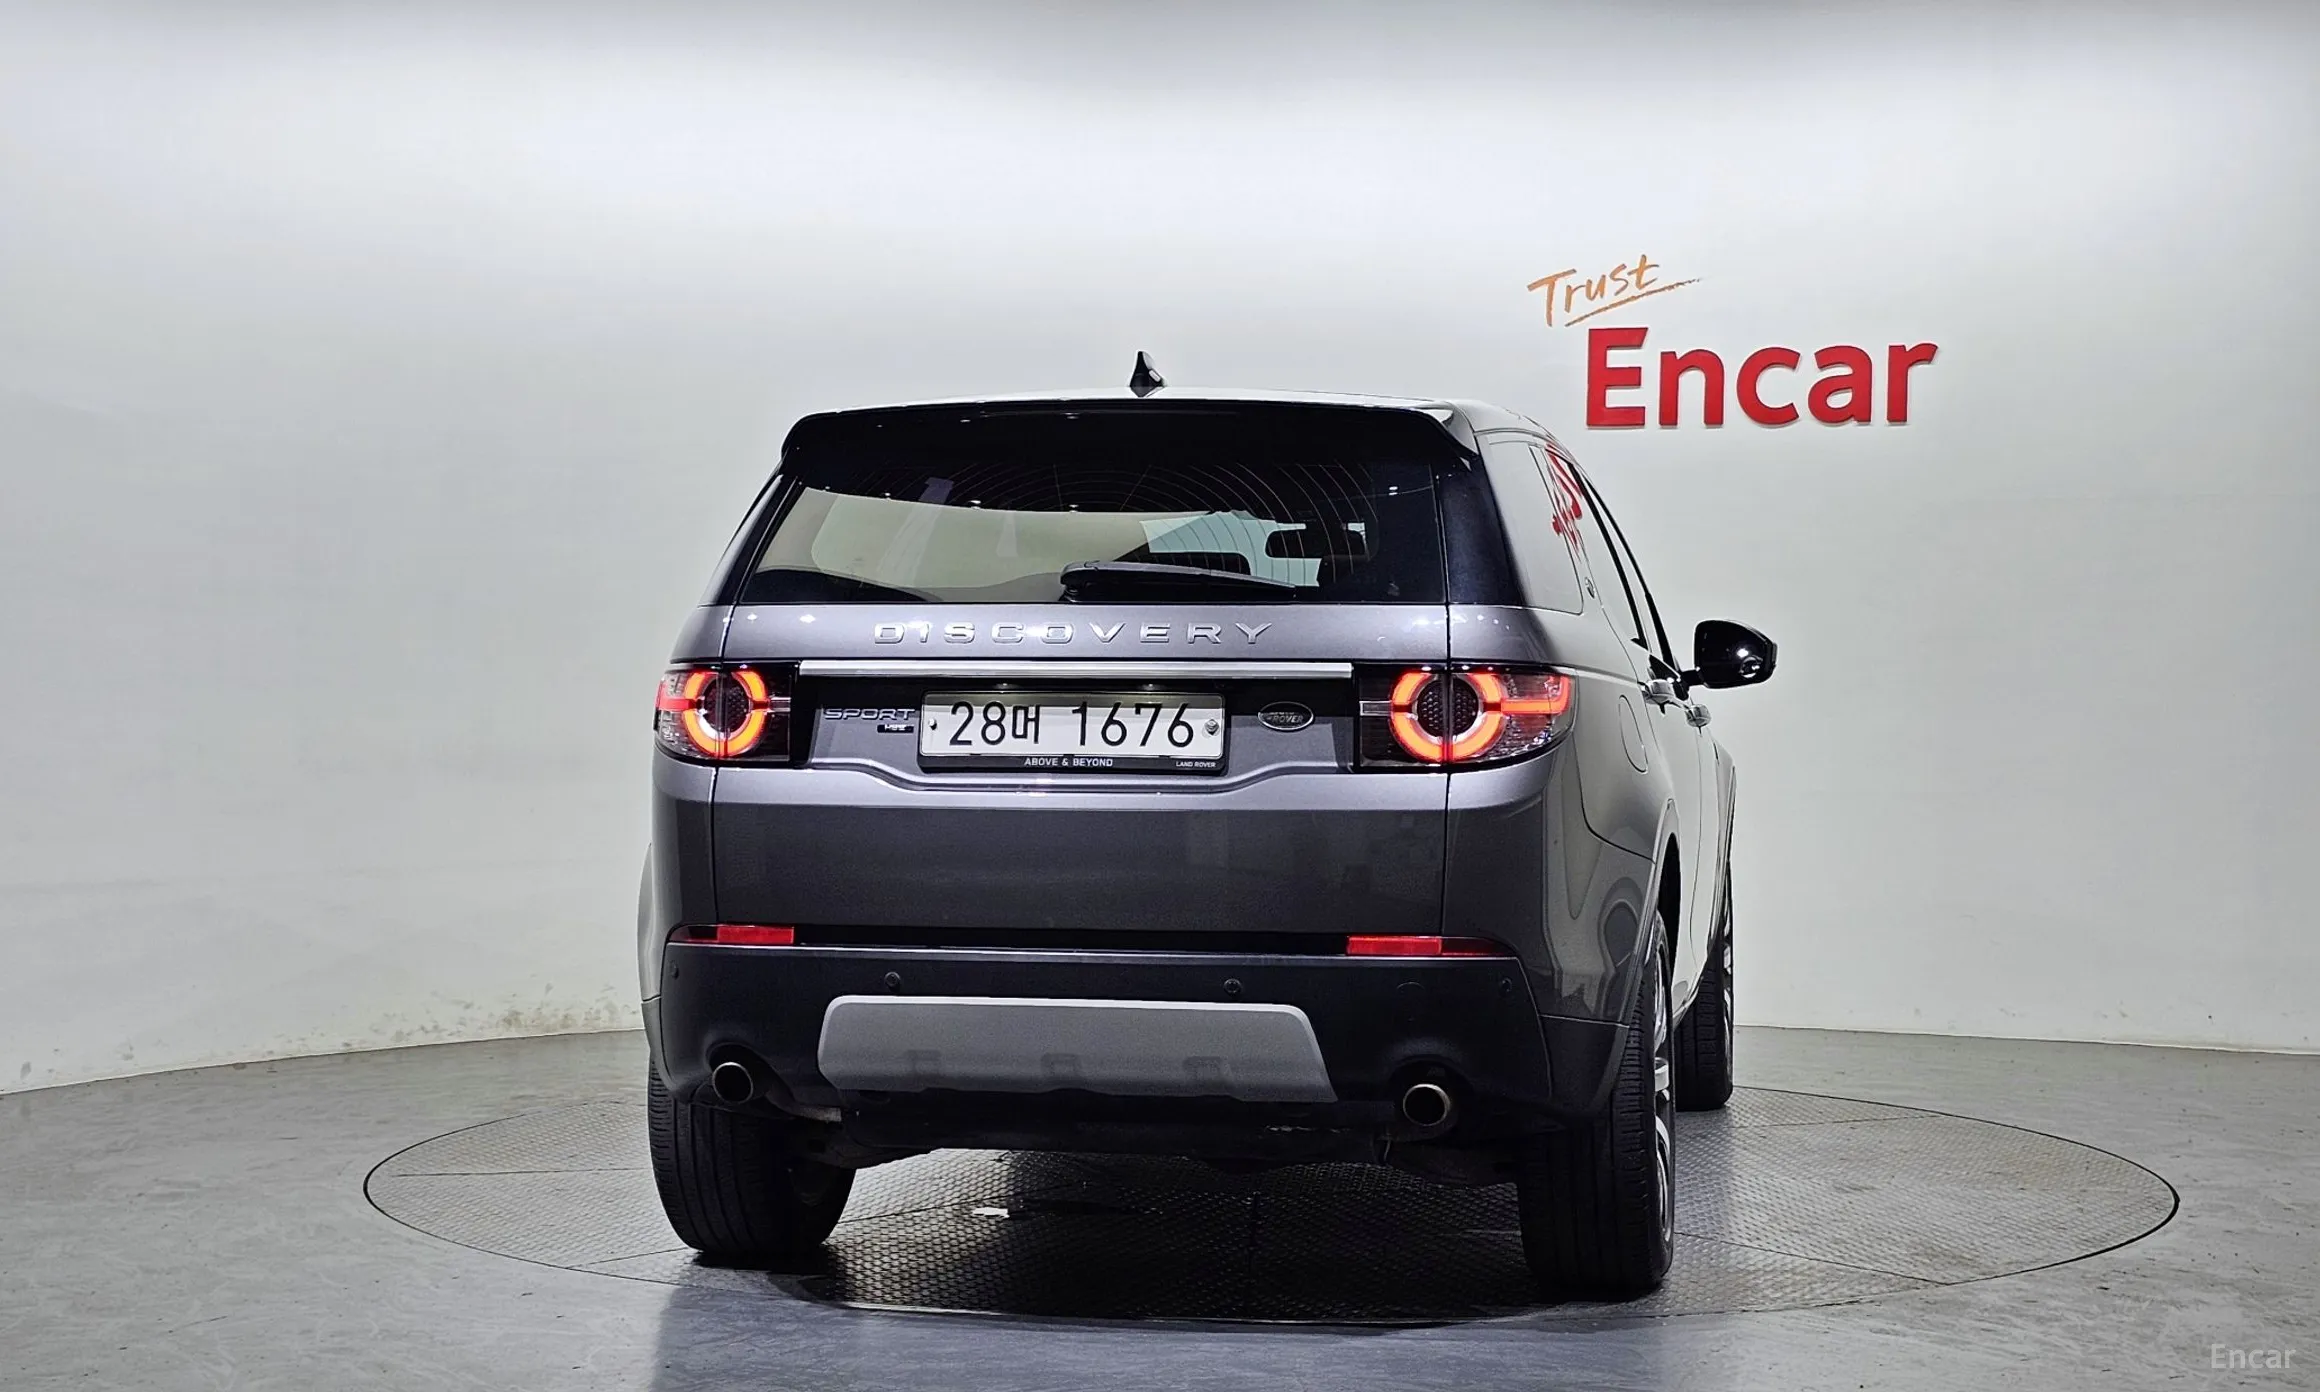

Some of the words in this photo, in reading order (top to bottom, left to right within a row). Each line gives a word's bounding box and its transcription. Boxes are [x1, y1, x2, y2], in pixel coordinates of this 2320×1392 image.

[1527, 254, 1660, 327] Trust
[1586, 327, 1938, 428] Encar
[874, 621, 1273, 644] DISCOVERY
[824, 708, 915, 720] SPORT
[949, 701, 1040, 746] 28머
[1072, 701, 1194, 748] 1676
[1024, 757, 1058, 767] ABOVE
[1061, 757, 1069, 767] &
[1073, 758, 1113, 767] BEYOND
